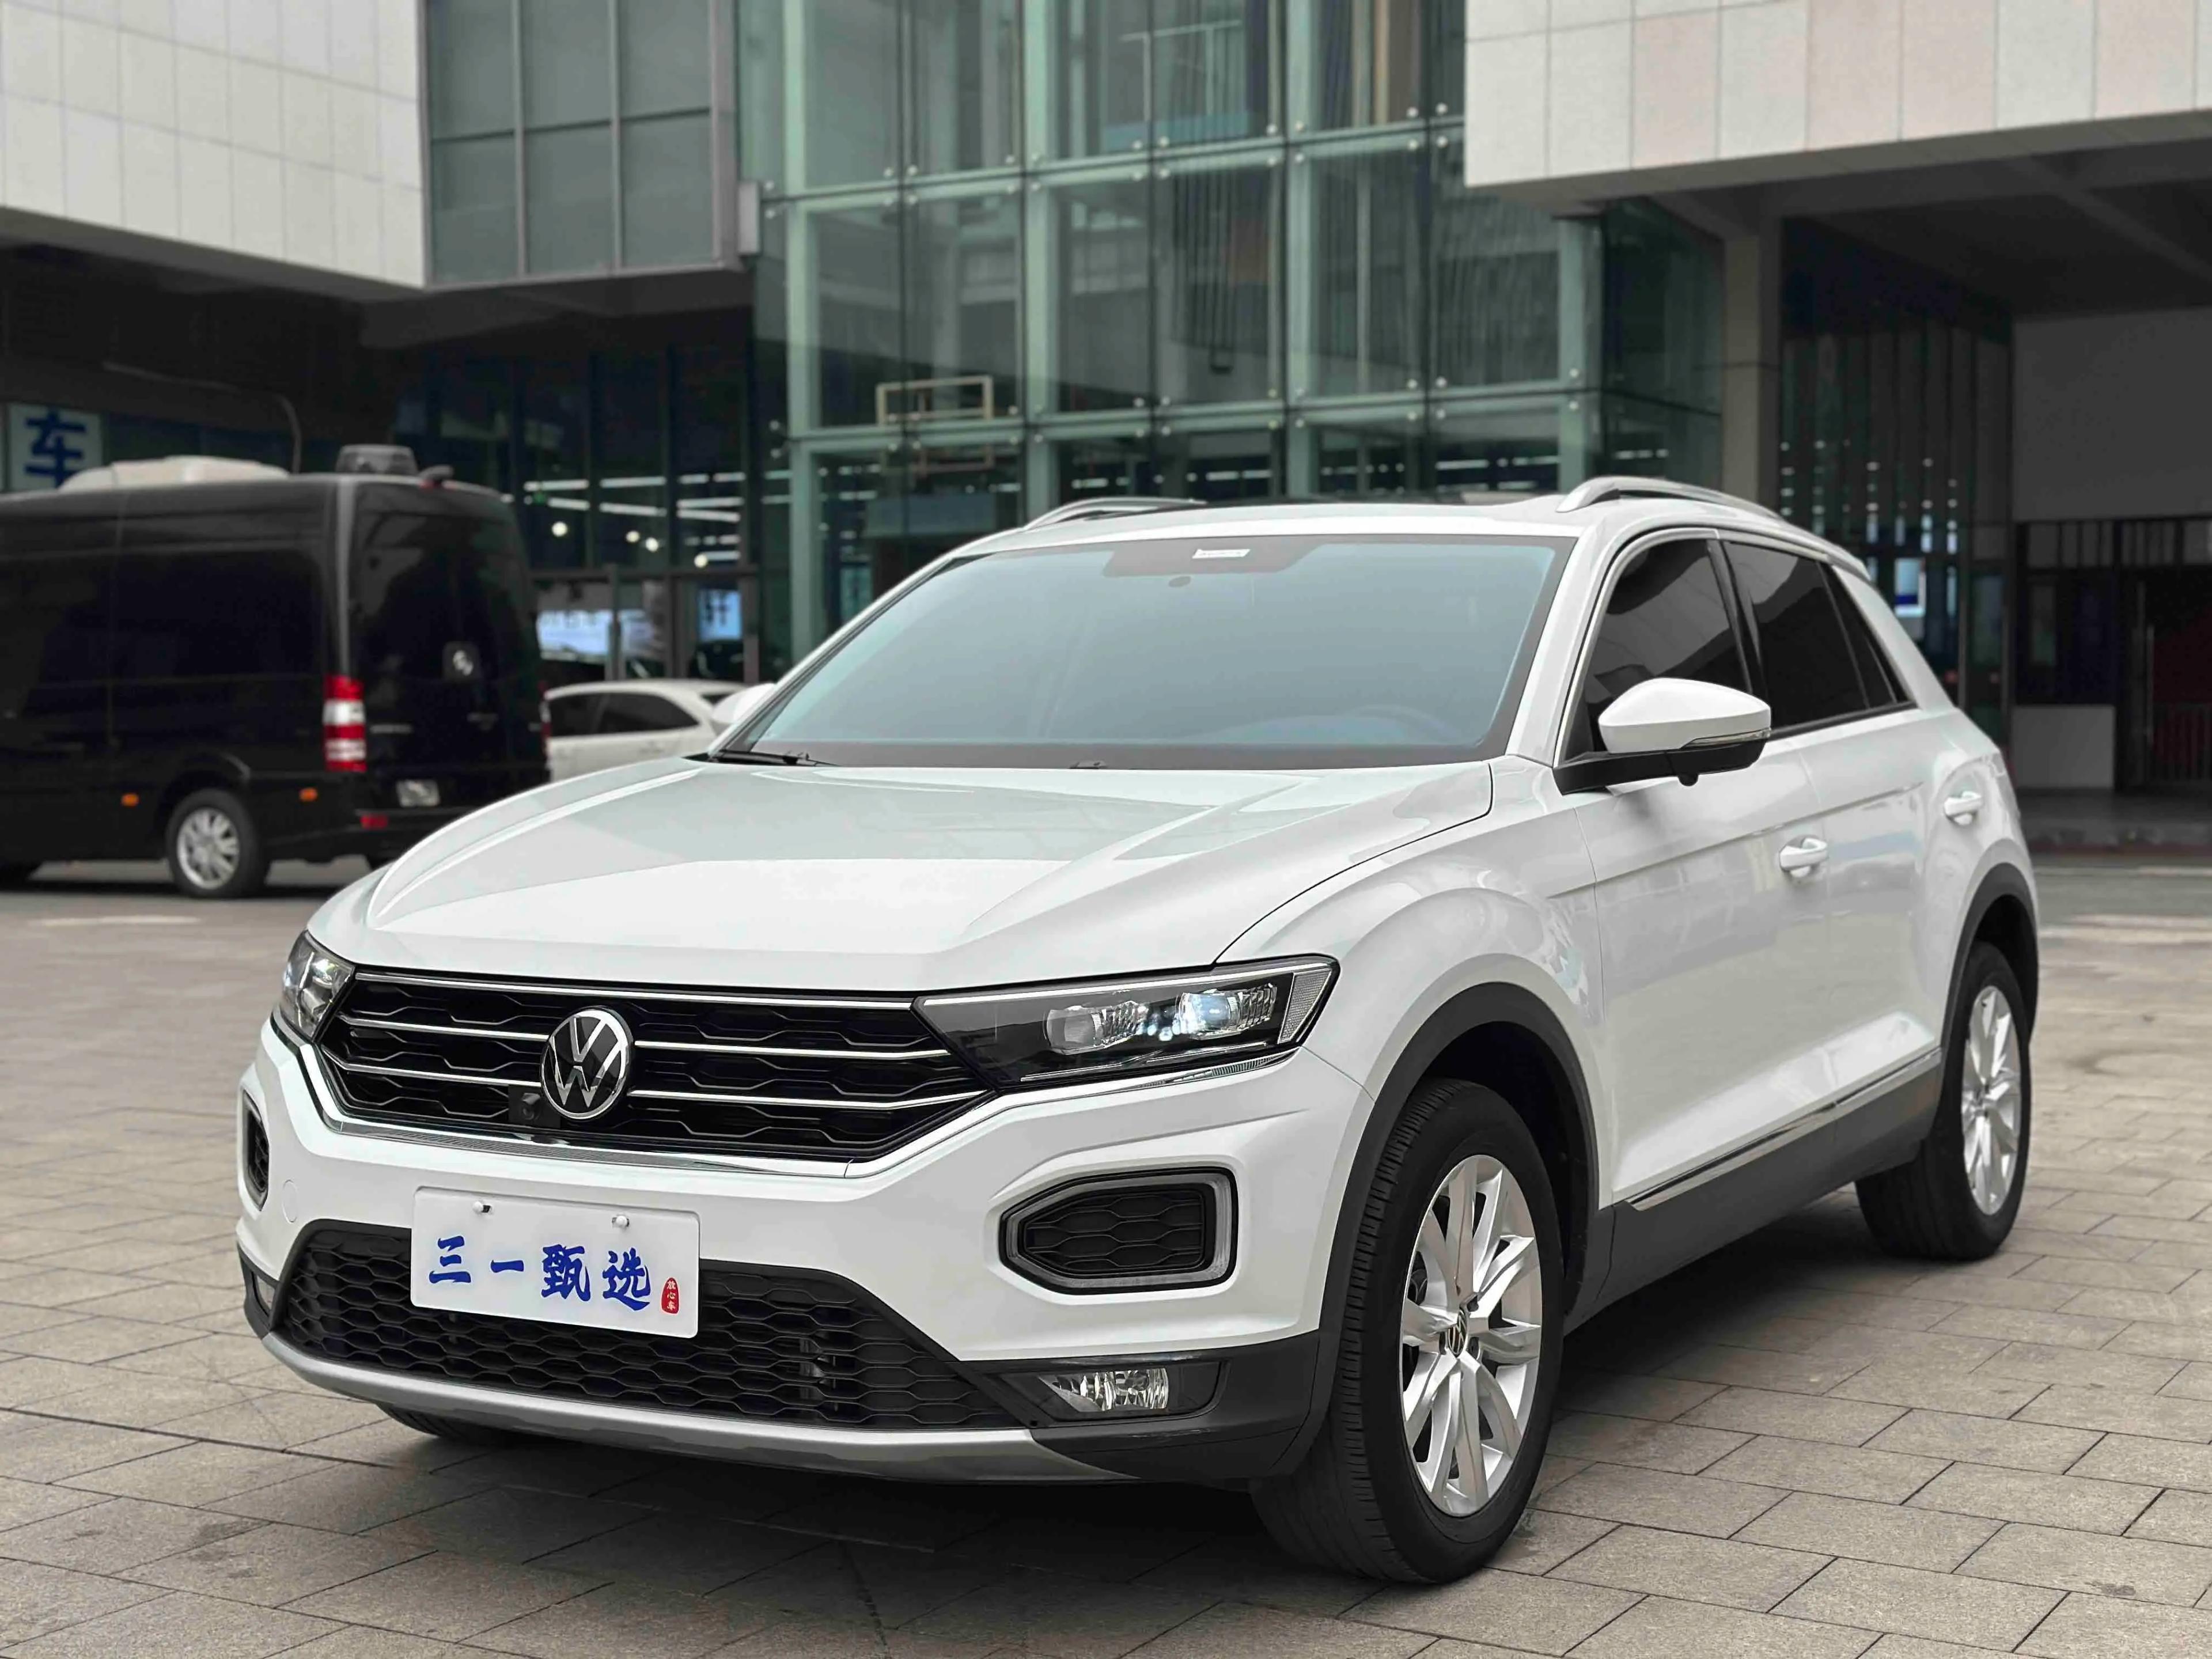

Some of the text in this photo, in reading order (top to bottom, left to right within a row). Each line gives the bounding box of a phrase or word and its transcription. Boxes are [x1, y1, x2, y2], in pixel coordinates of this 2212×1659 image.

[24, 406, 86, 488] 车
[545, 1010, 629, 1109] VW
[429, 1234, 651, 1311] 三一甄选
